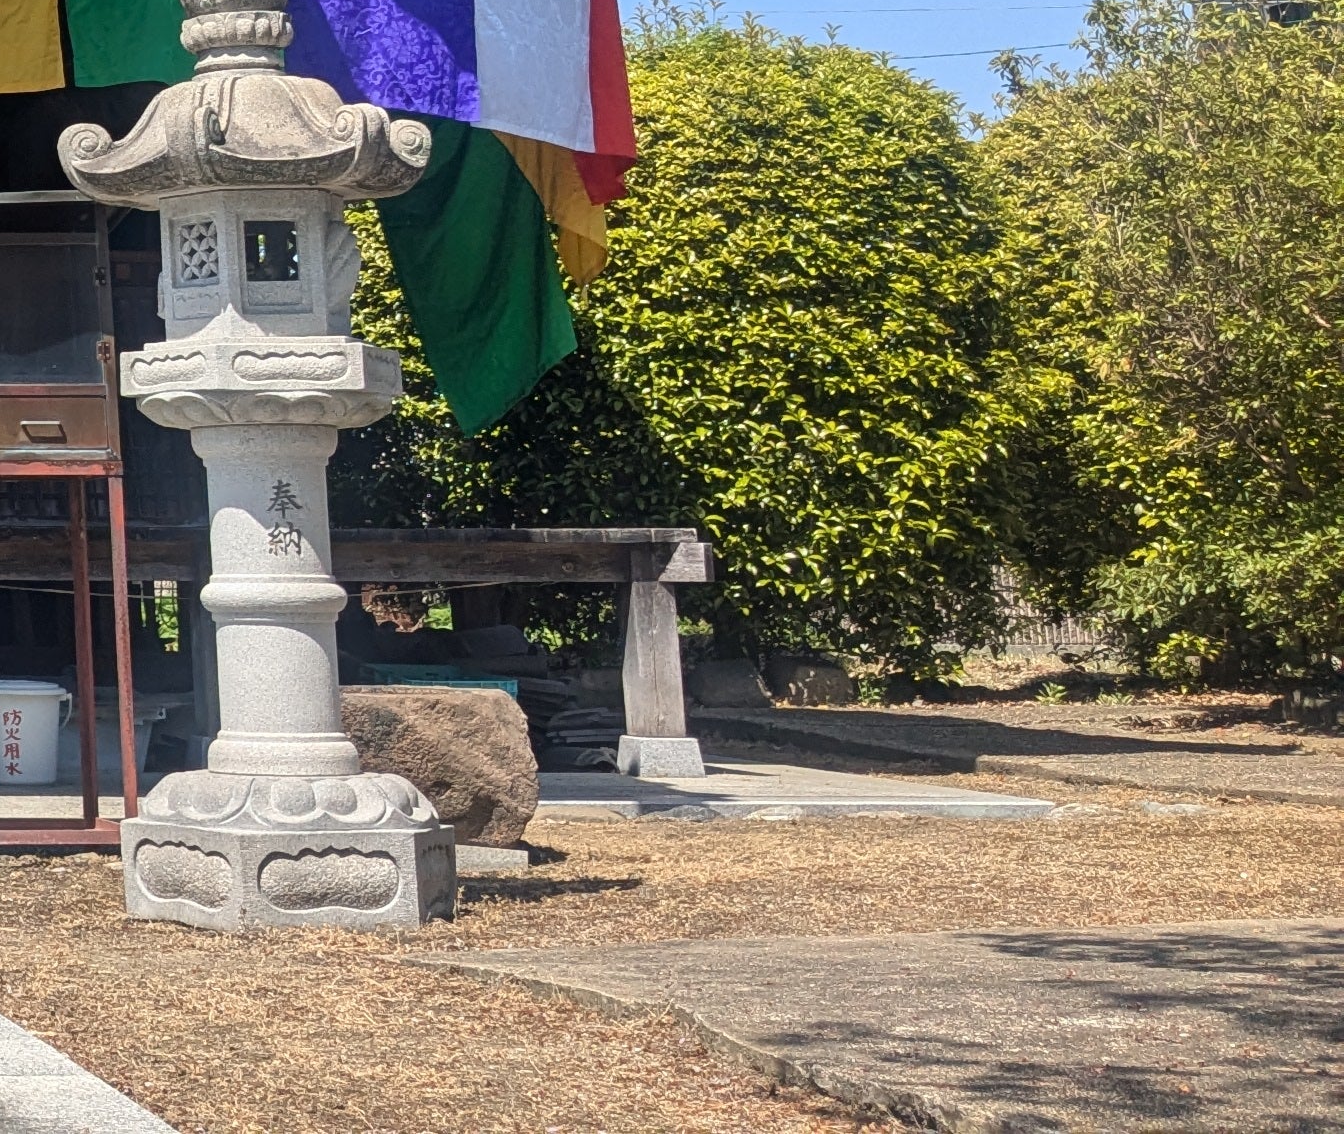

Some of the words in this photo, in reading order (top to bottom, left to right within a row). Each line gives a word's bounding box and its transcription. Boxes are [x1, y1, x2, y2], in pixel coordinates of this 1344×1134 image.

[266, 479, 303, 556] 奉納
[2, 709, 23, 776] 防火用水
